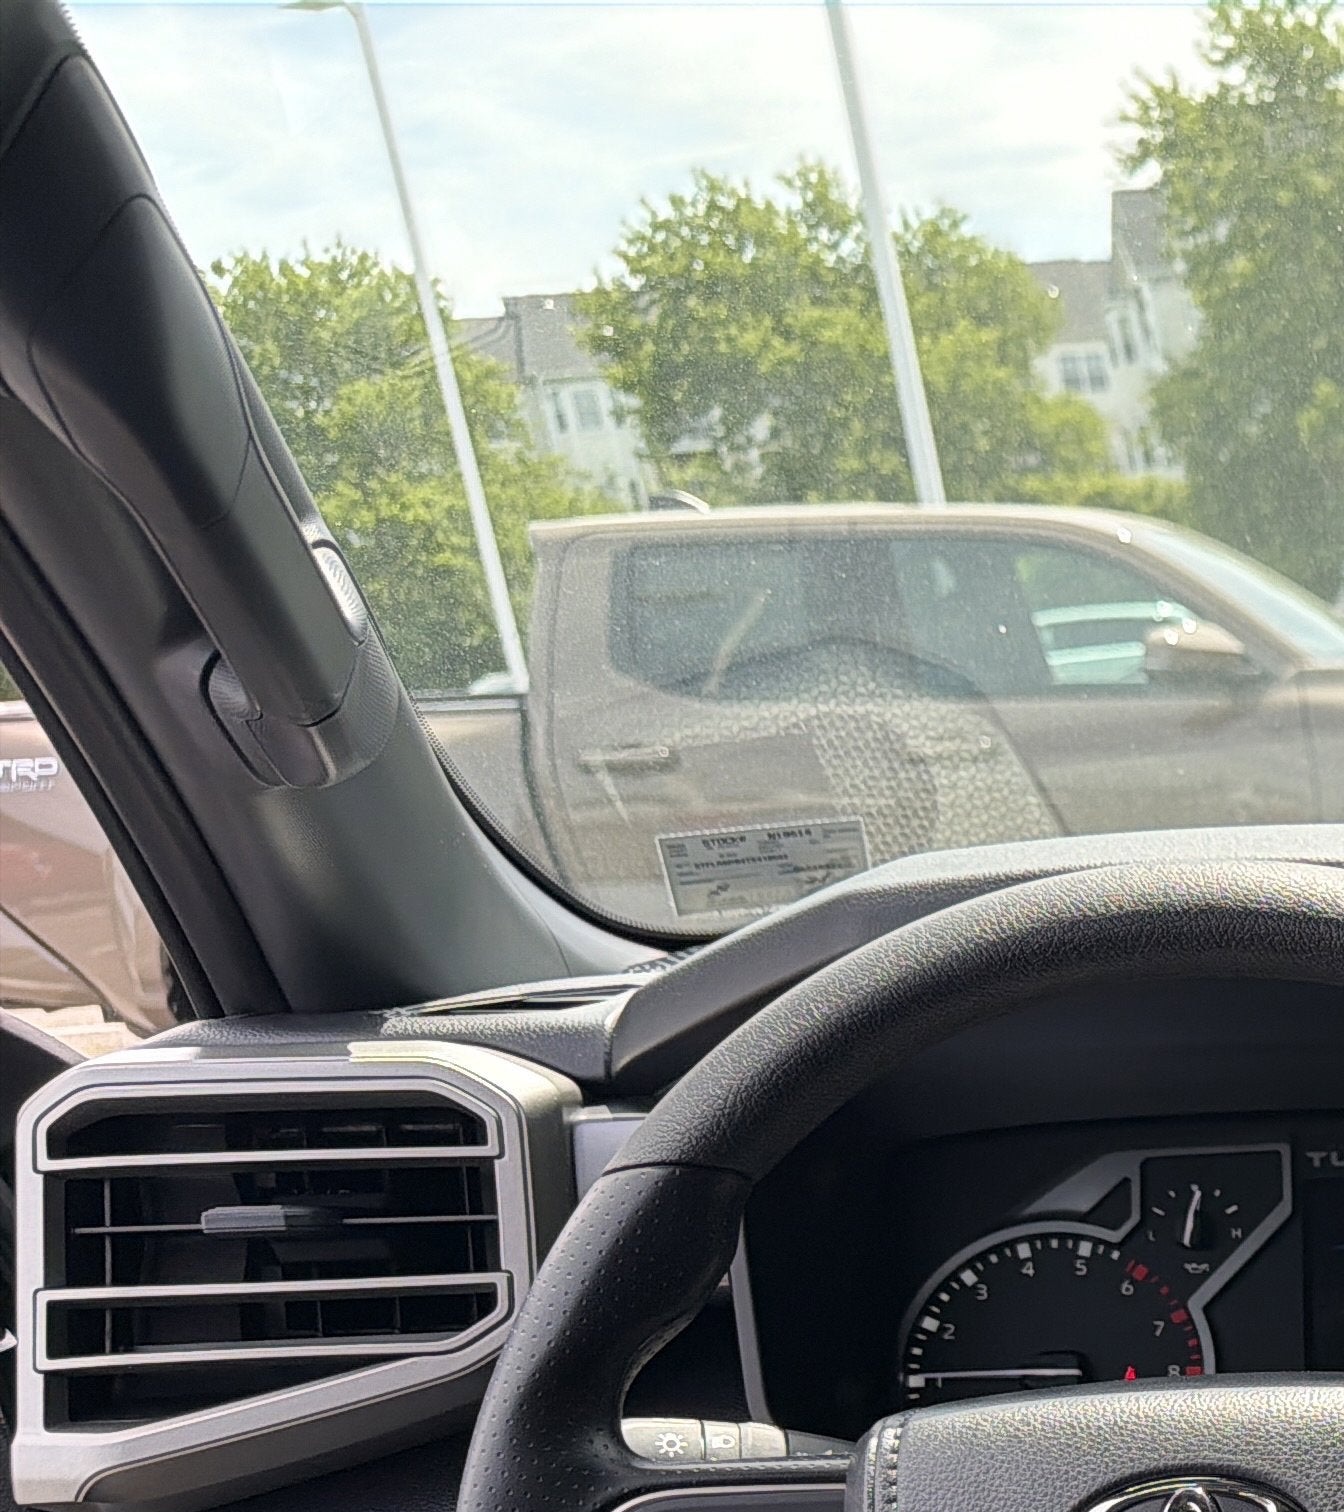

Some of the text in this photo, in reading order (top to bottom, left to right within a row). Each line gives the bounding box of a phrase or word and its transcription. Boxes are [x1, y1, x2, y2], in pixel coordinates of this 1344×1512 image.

[1230, 1228, 1243, 1240] H
[1020, 1262, 1035, 1278] 4
[1075, 1261, 1088, 1276] 5
[976, 1285, 988, 1300] 3
[1121, 1281, 1134, 1296] 6
[941, 1324, 956, 1340] 2
[1153, 1320, 1166, 1337] 7
[1168, 1364, 1181, 1378] 8
